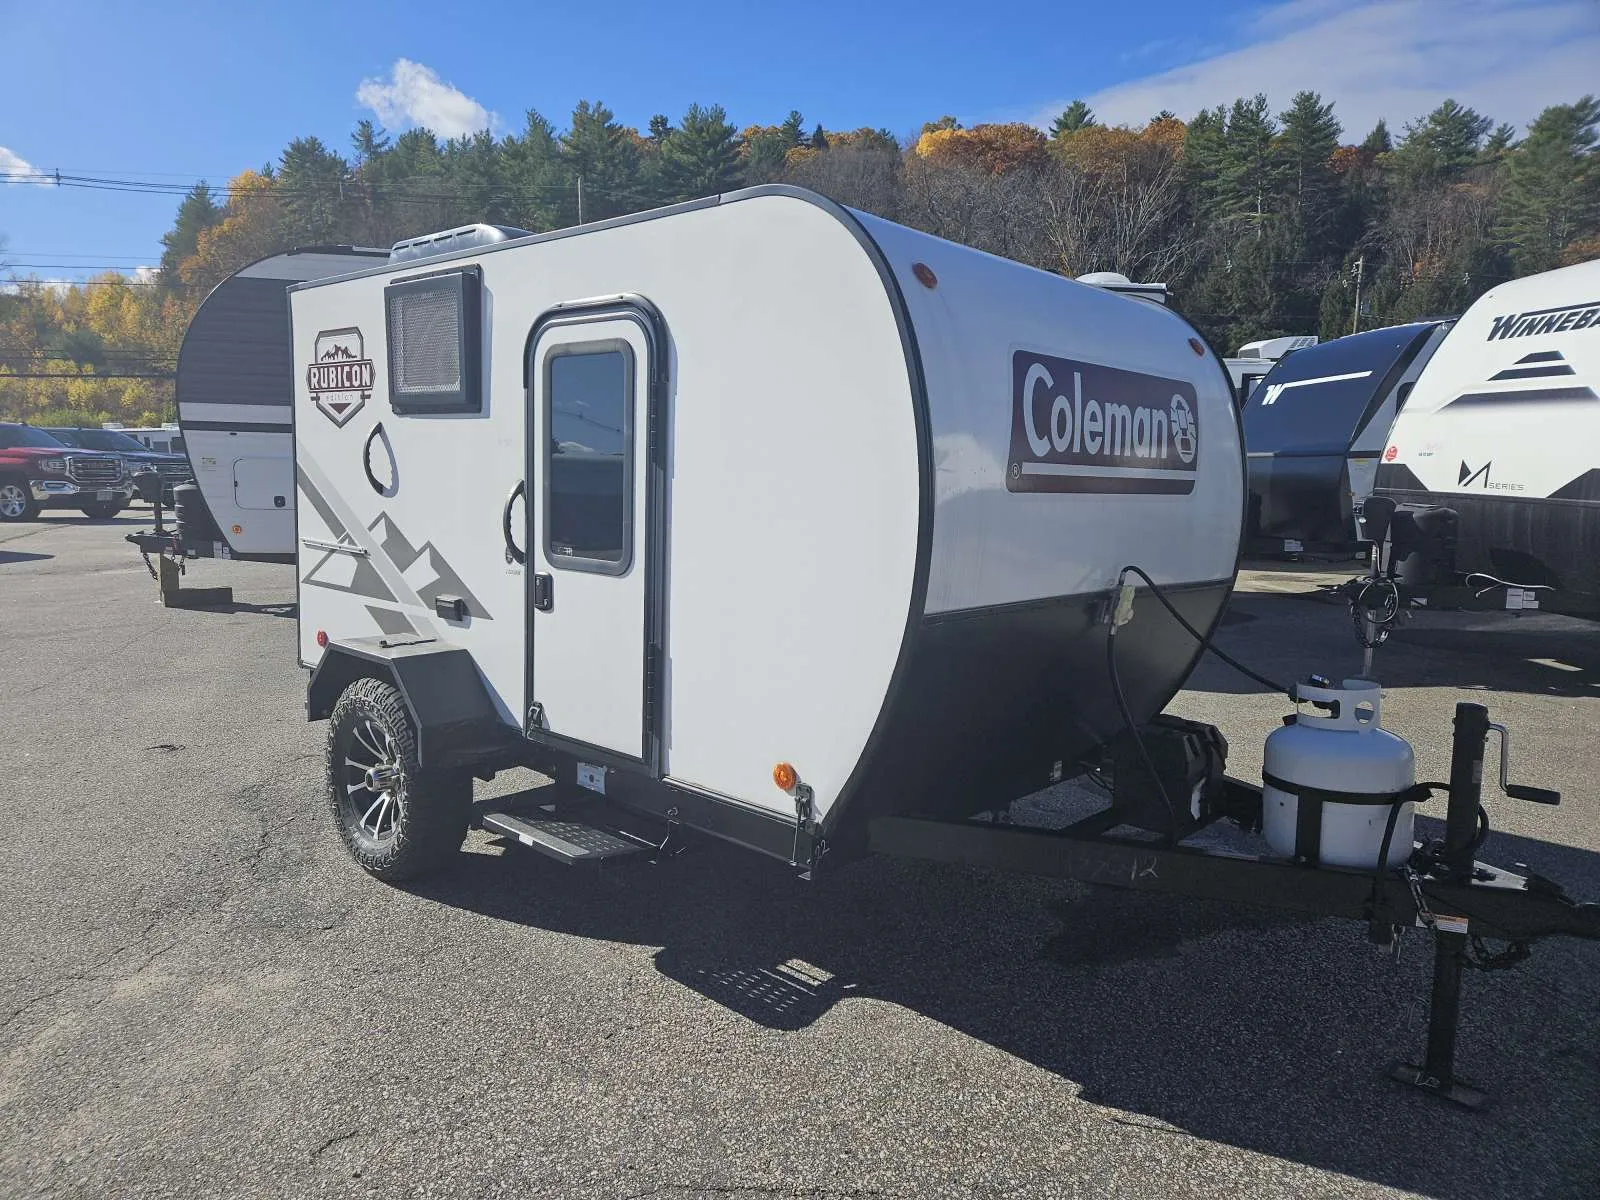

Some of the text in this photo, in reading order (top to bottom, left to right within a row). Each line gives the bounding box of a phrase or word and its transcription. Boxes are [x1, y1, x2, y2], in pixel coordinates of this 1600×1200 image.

[310, 365, 371, 389] RUBICON
[1023, 362, 1168, 459] Coleman
[1488, 482, 1526, 491] SERIES
